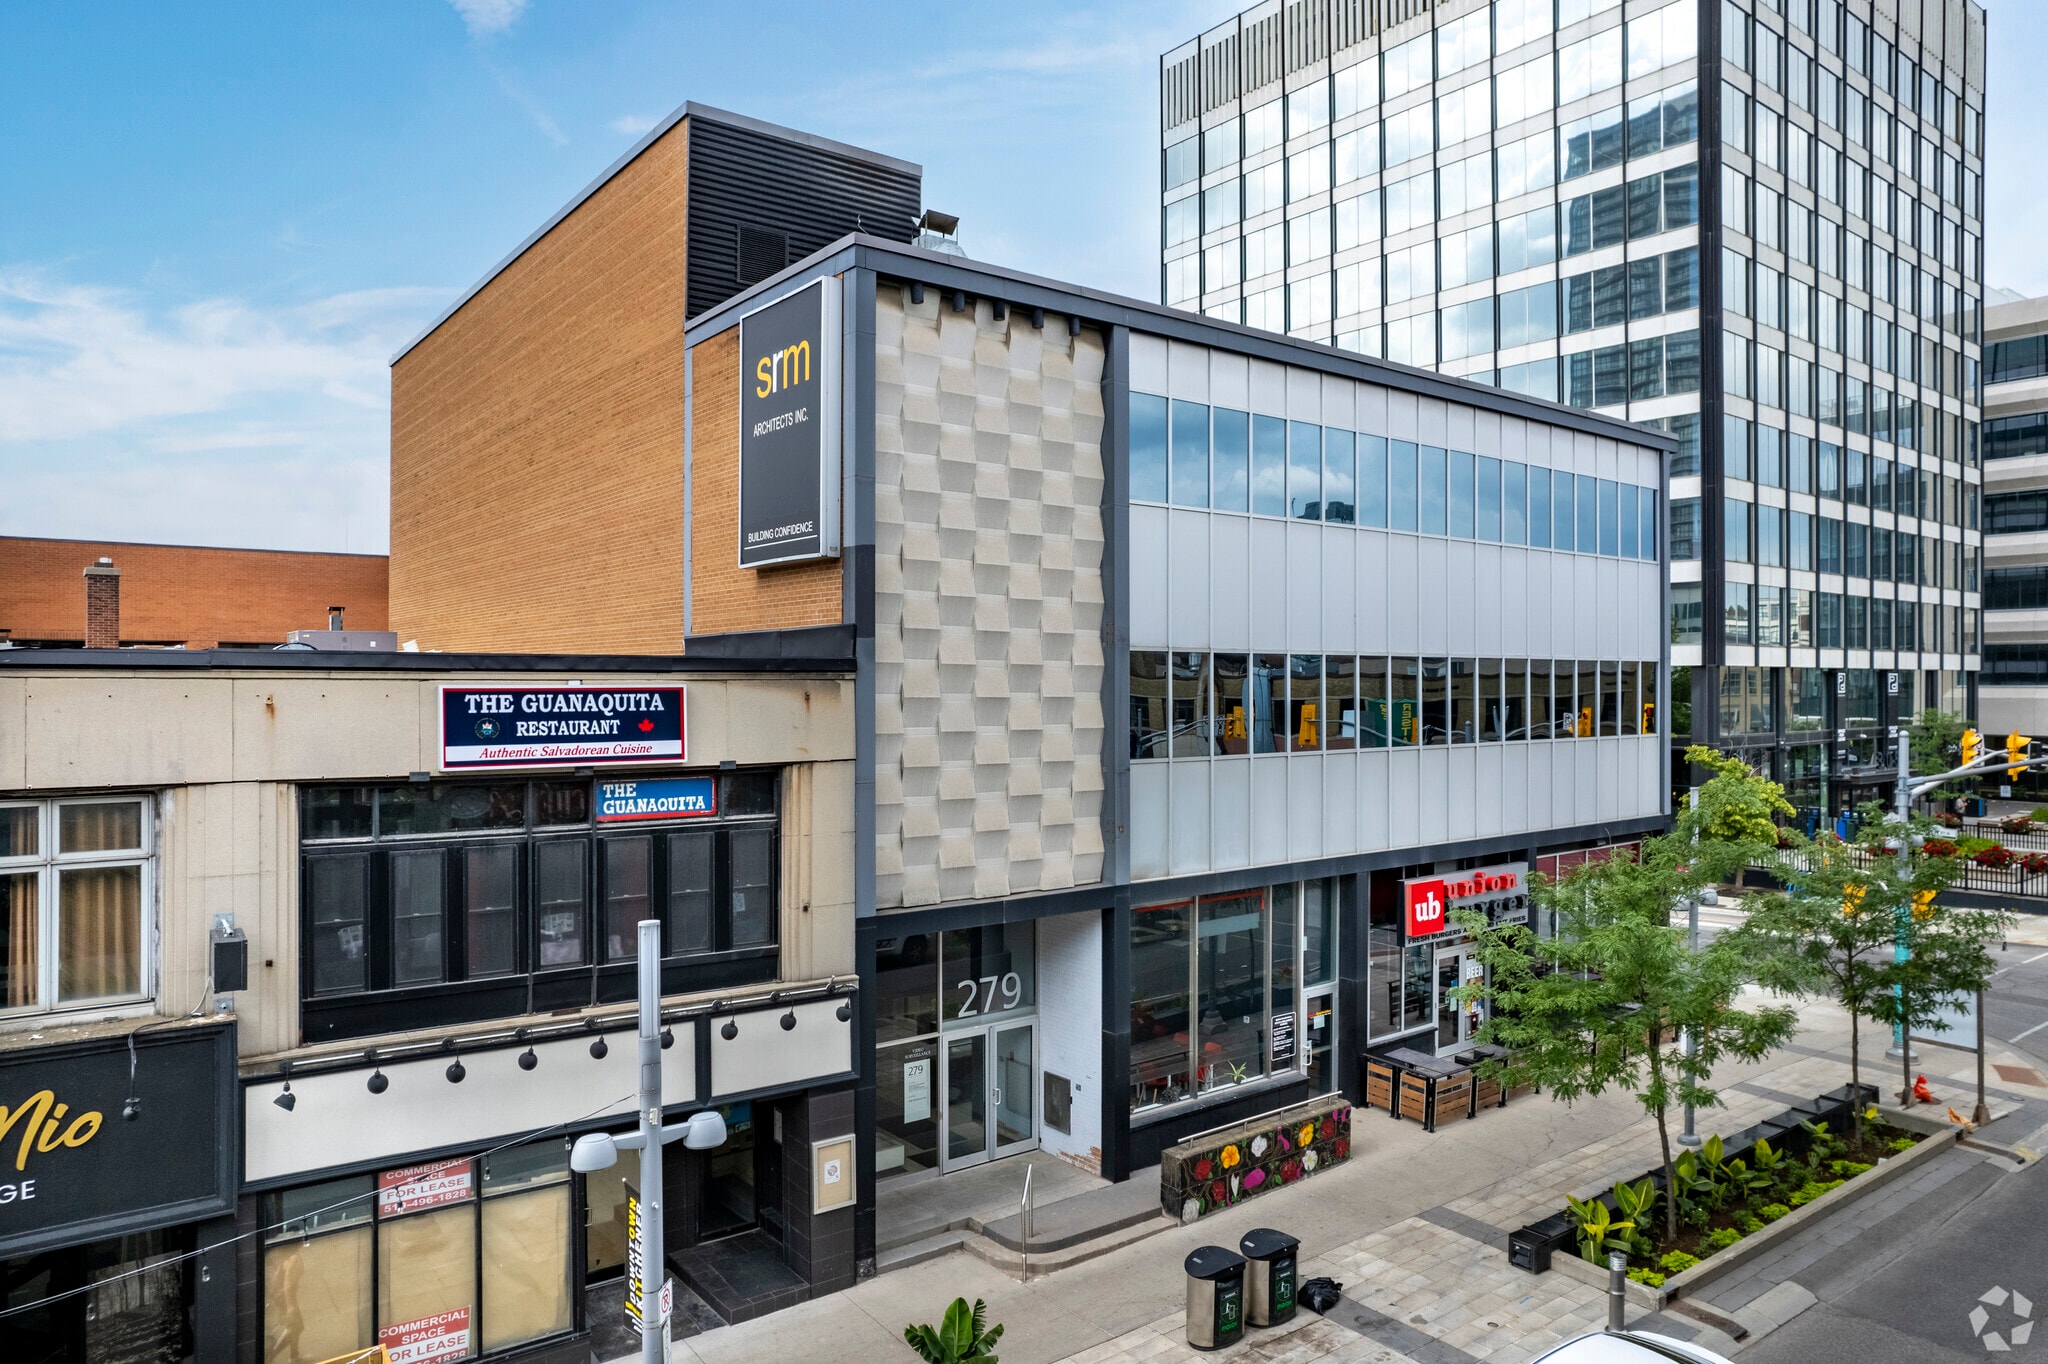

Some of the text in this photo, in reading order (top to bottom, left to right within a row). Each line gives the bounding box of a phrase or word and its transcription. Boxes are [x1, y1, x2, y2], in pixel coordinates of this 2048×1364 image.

[755, 339, 811, 399] srm
[753, 407, 809, 438] ARCHITECTS INC.
[748, 521, 813, 543] BUILDING CONFIDENCE
[464, 692, 665, 716] THE GUANAQUITA
[516, 719, 621, 737] RESTAURANT
[479, 743, 653, 759] Authentic Salvadorean Cuisine
[603, 783, 637, 798] THE
[603, 796, 706, 814] GUANAQUITA
[1446, 872, 1518, 900] union
[1415, 891, 1441, 922] ub
[1408, 934, 1430, 945] FRESH
[1431, 928, 1462, 941] BURGERS
[1466, 965, 1484, 979] BEER
[957, 971, 1022, 1018] 279
[908, 1064, 924, 1076] 279
[386, 1177, 465, 1200] FOR LEASE
[628, 1196, 637, 1306] DOWNTOWN
[378, 1310, 469, 1338] COMMERCIAL
[401, 1326, 446, 1345] SPACE
[390, 1334, 466, 1362] OR LEASE
